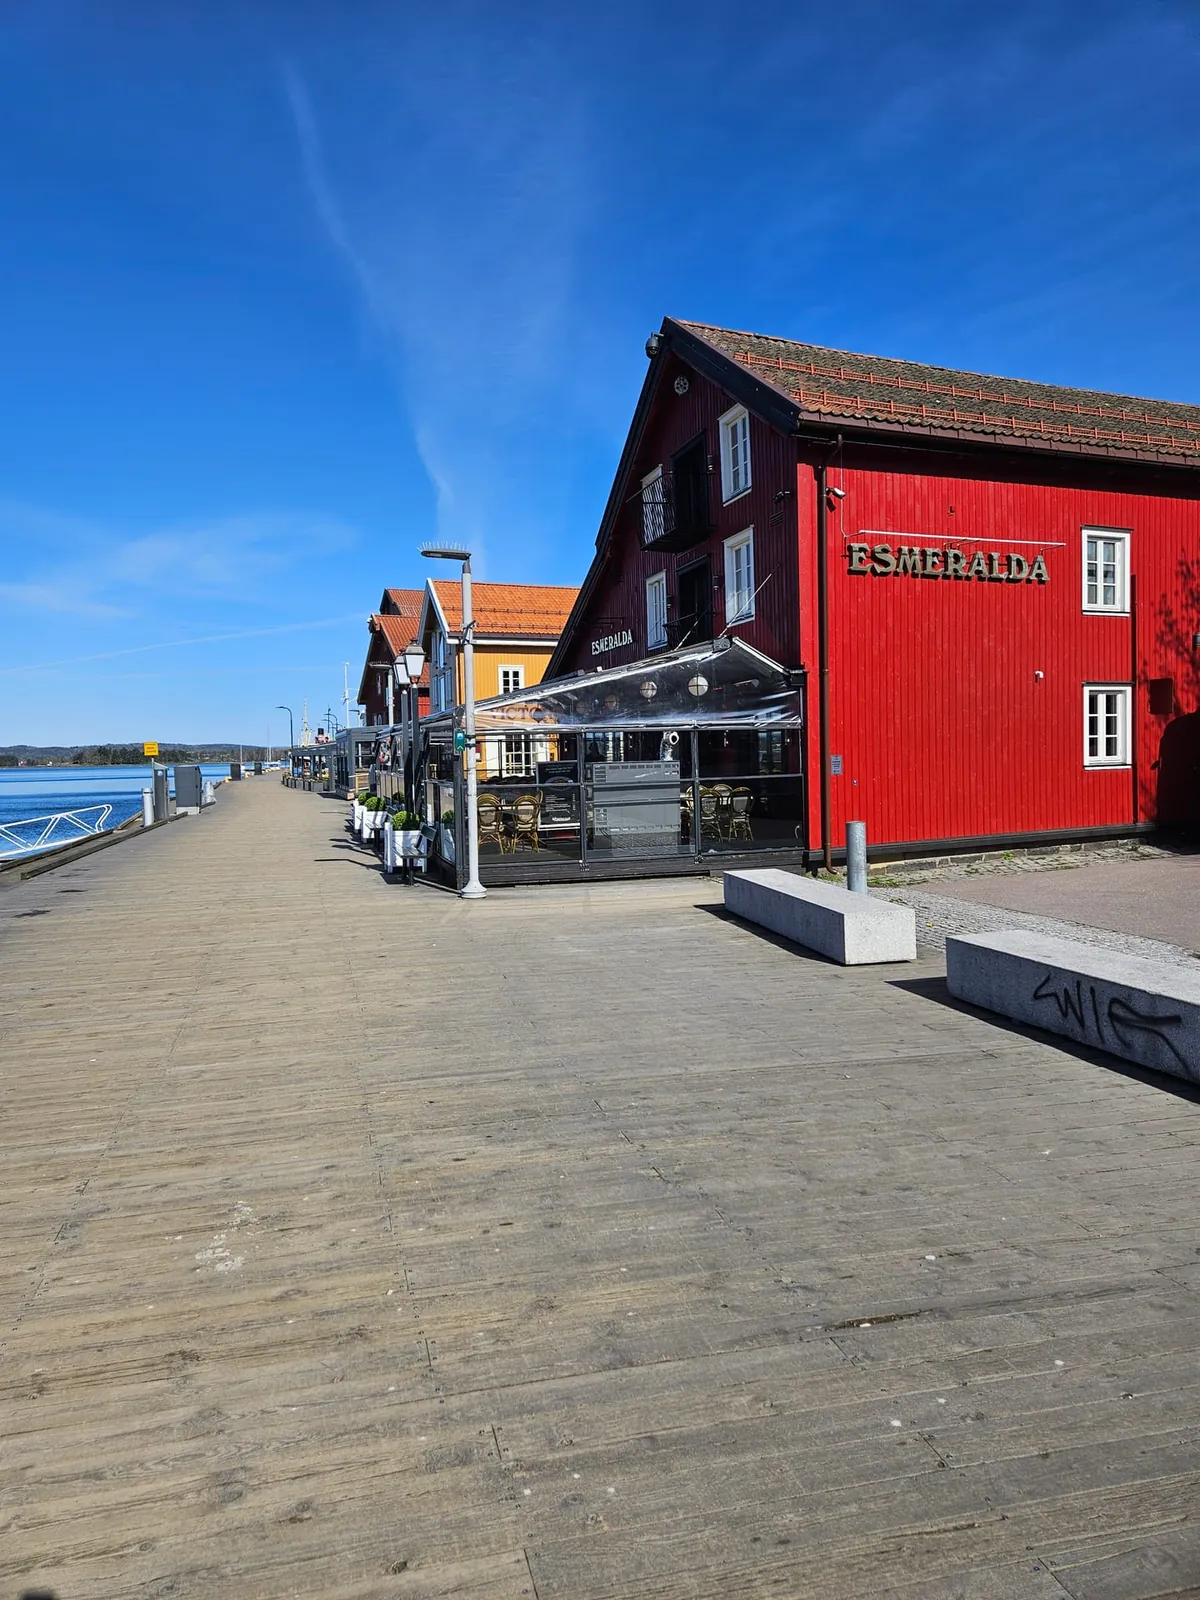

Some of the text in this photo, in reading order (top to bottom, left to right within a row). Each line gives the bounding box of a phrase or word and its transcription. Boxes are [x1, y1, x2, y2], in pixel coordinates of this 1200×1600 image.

[848, 543, 1050, 583] ESMERALDA
[591, 629, 633, 656] ESMERALDA
[490, 704, 551, 722] VICTO
